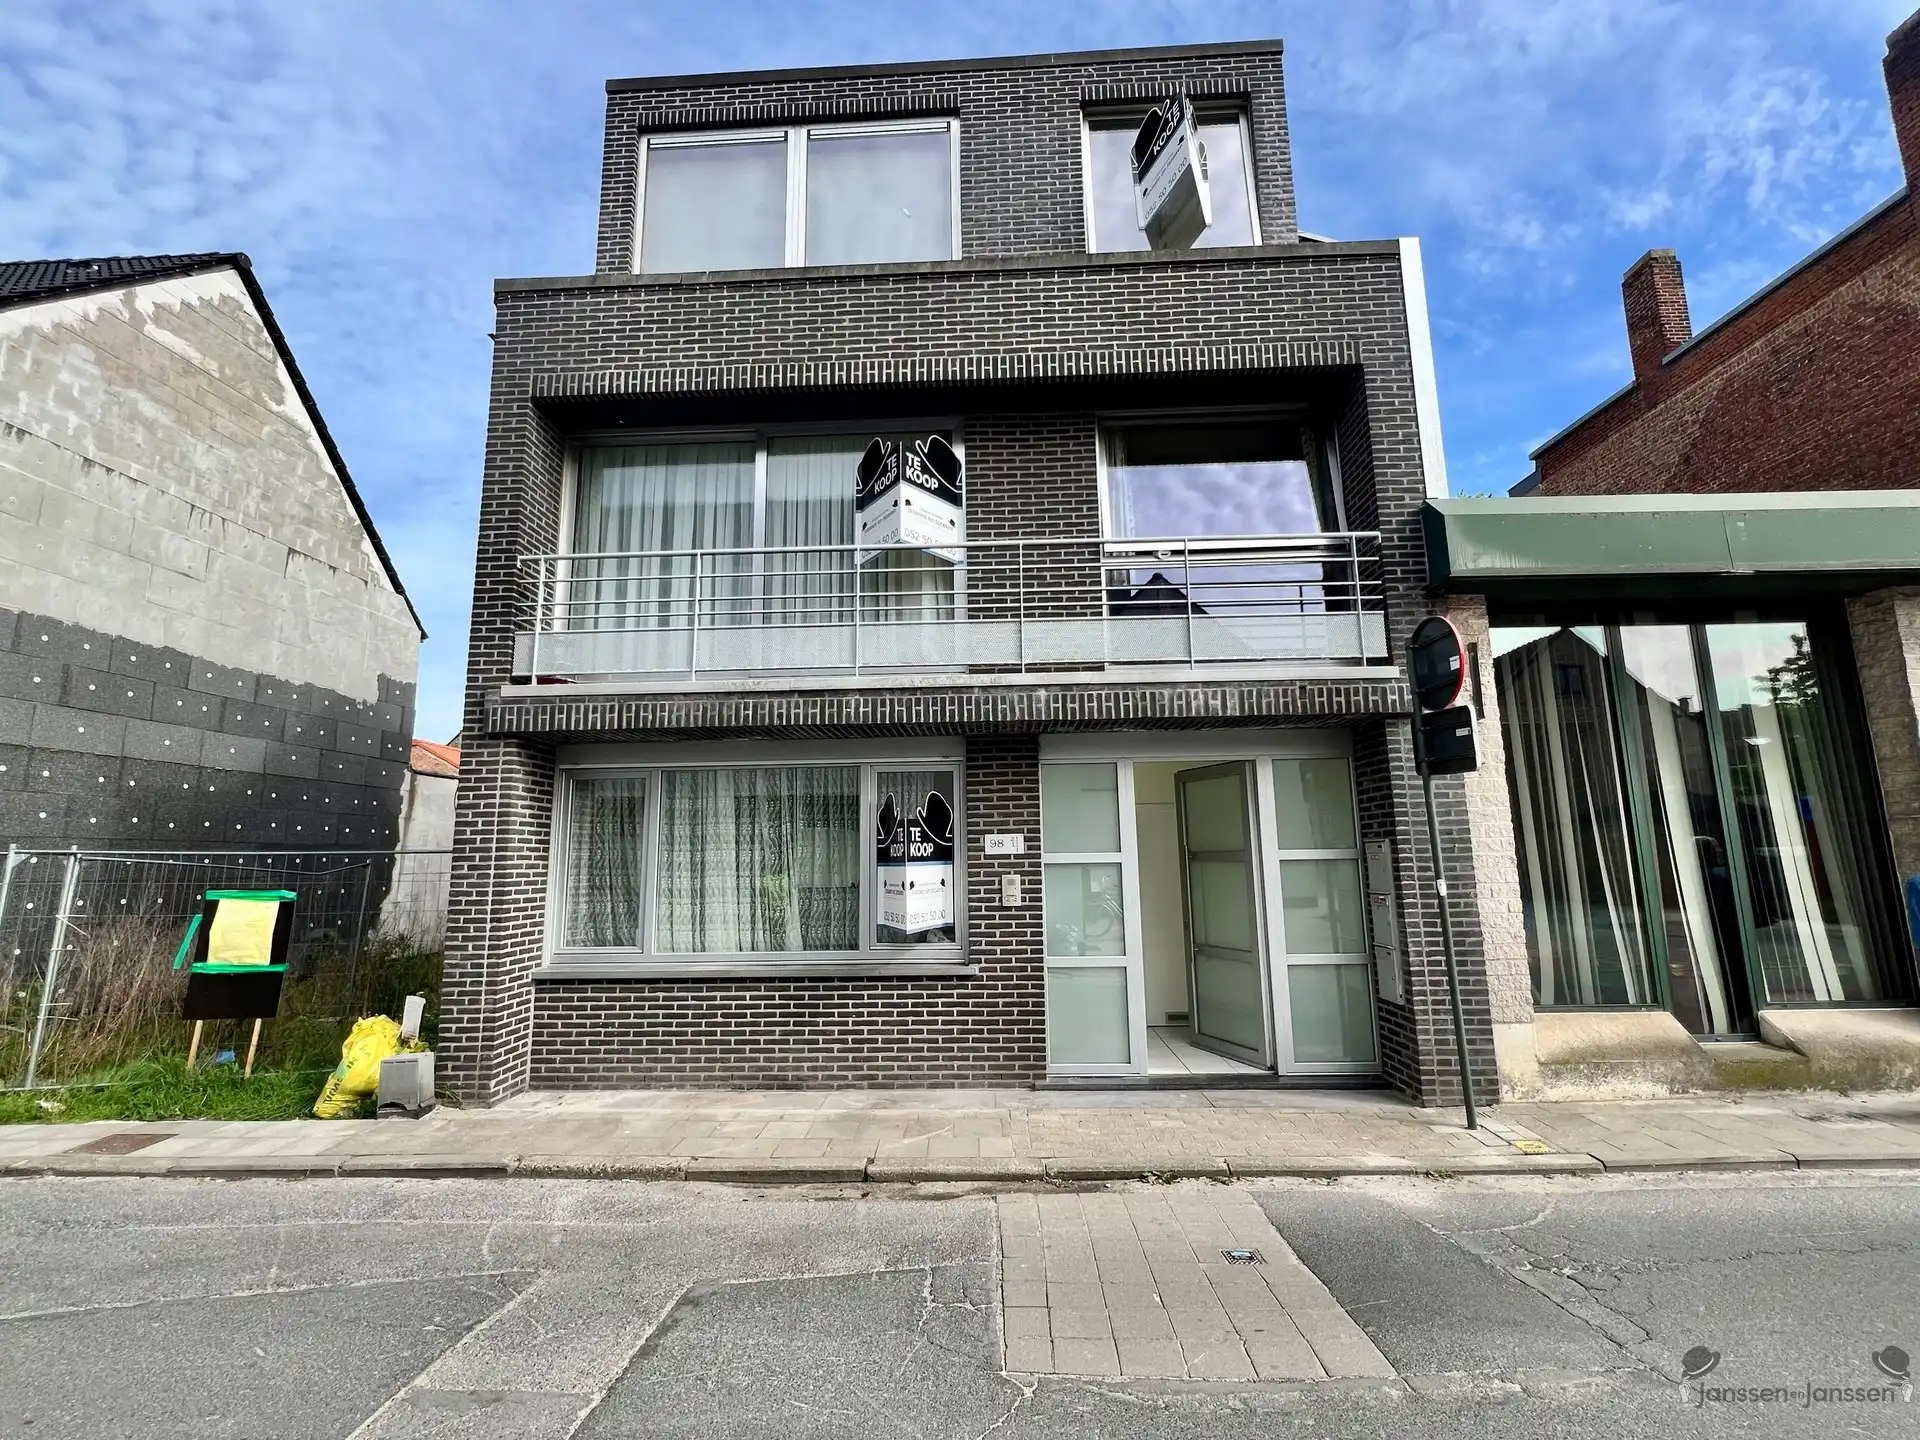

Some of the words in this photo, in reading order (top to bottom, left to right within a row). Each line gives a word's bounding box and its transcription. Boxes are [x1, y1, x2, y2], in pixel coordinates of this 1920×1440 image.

[1166, 100, 1180, 122] TE
[1153, 111, 1181, 155] KOOP
[1168, 173, 1177, 187] 50
[886, 453, 898, 471] TE
[905, 452, 921, 470] TE
[874, 468, 898, 495] KOOP
[906, 465, 939, 491] KOOP
[897, 828, 904, 841] TE
[910, 828, 921, 841] TE
[890, 844, 904, 857] KOOP
[910, 843, 934, 857] KOOP
[990, 838, 1004, 848] 98
